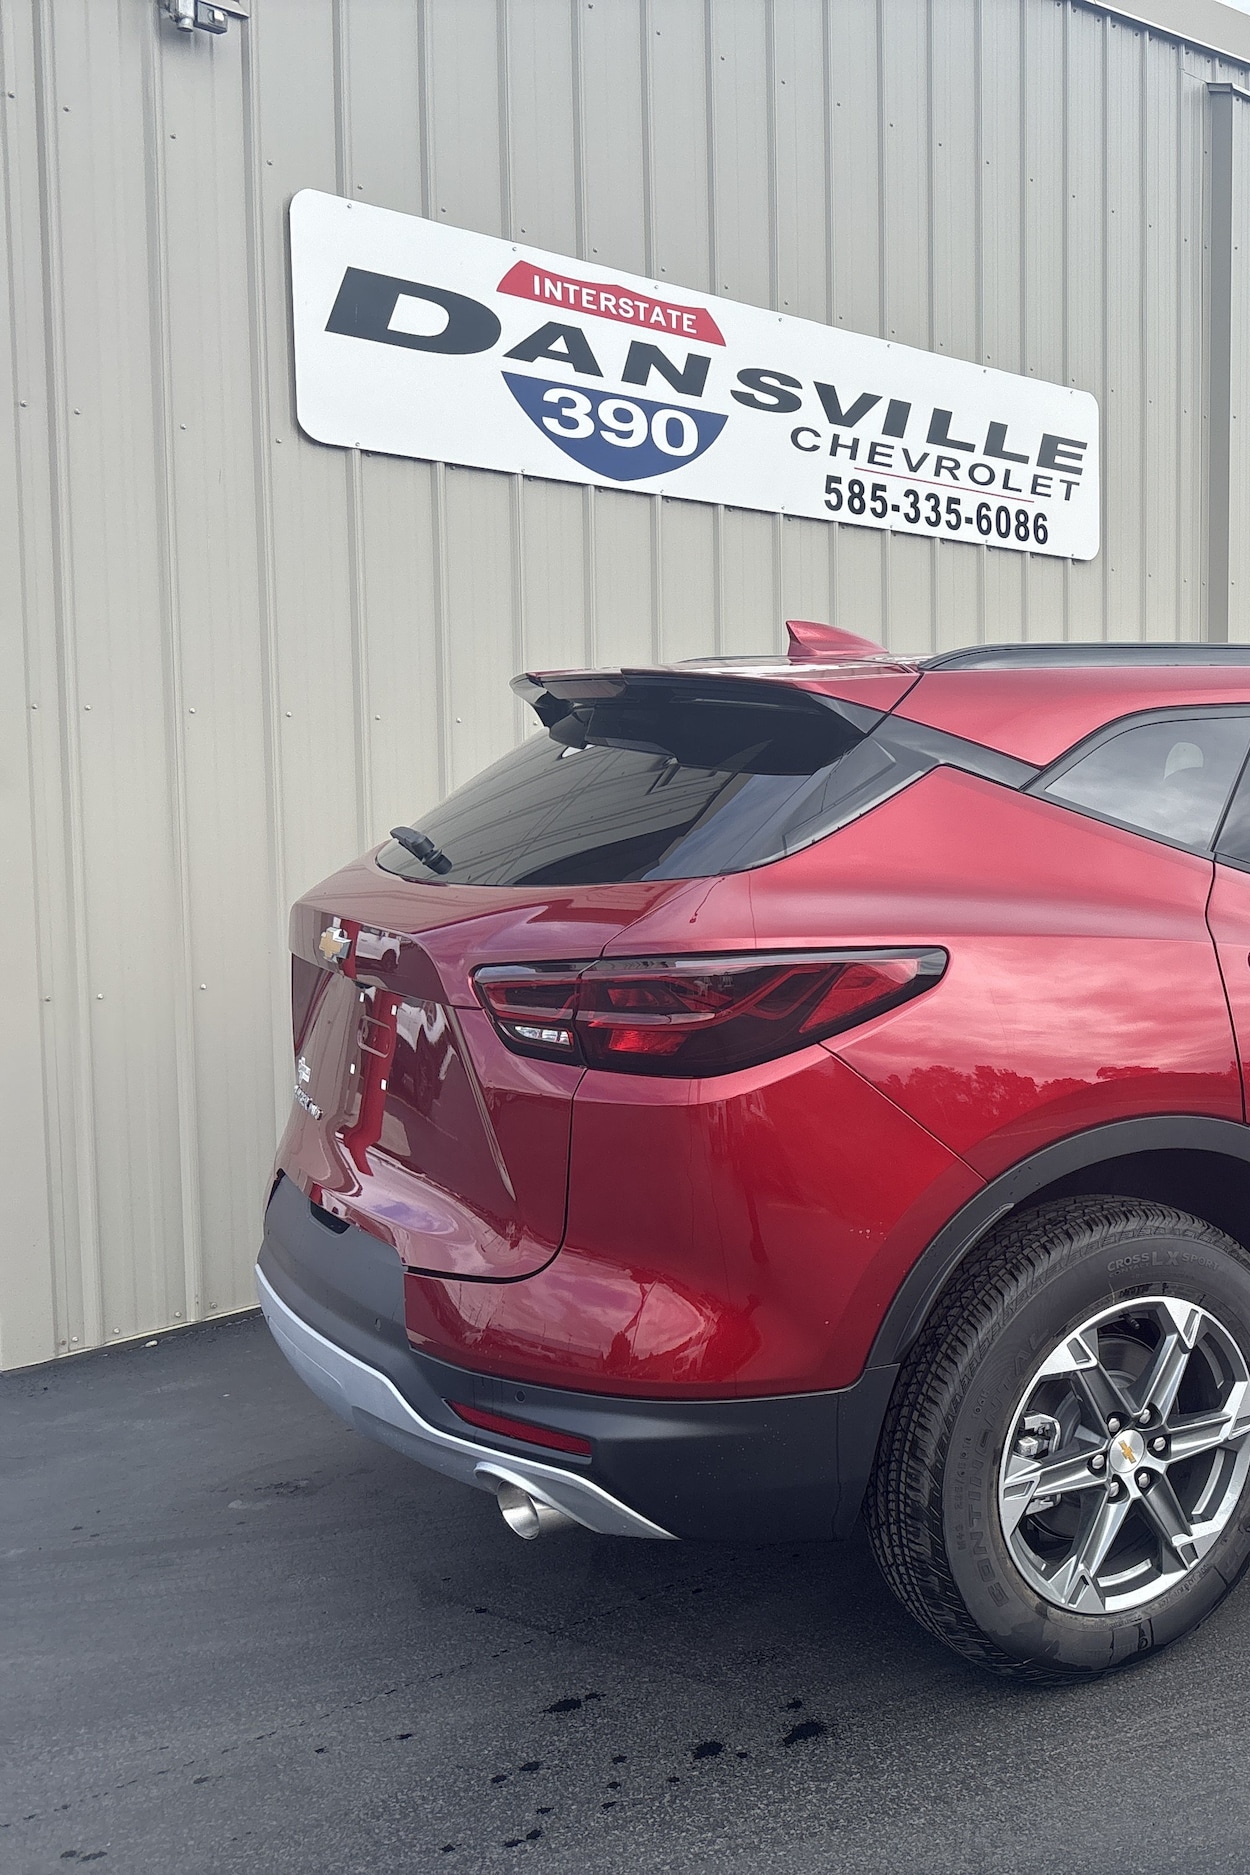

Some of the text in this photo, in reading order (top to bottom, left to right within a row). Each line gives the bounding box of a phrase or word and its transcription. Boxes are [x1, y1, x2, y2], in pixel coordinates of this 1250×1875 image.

[533, 274, 698, 335] INTERSTATE
[325, 266, 1088, 476] DANSVILLE
[541, 387, 700, 458] 390
[790, 426, 1080, 501] CHEVROLET
[823, 474, 1049, 545] 585-335-6086
[1106, 1250, 1220, 1272] CROSS LX SPORT
